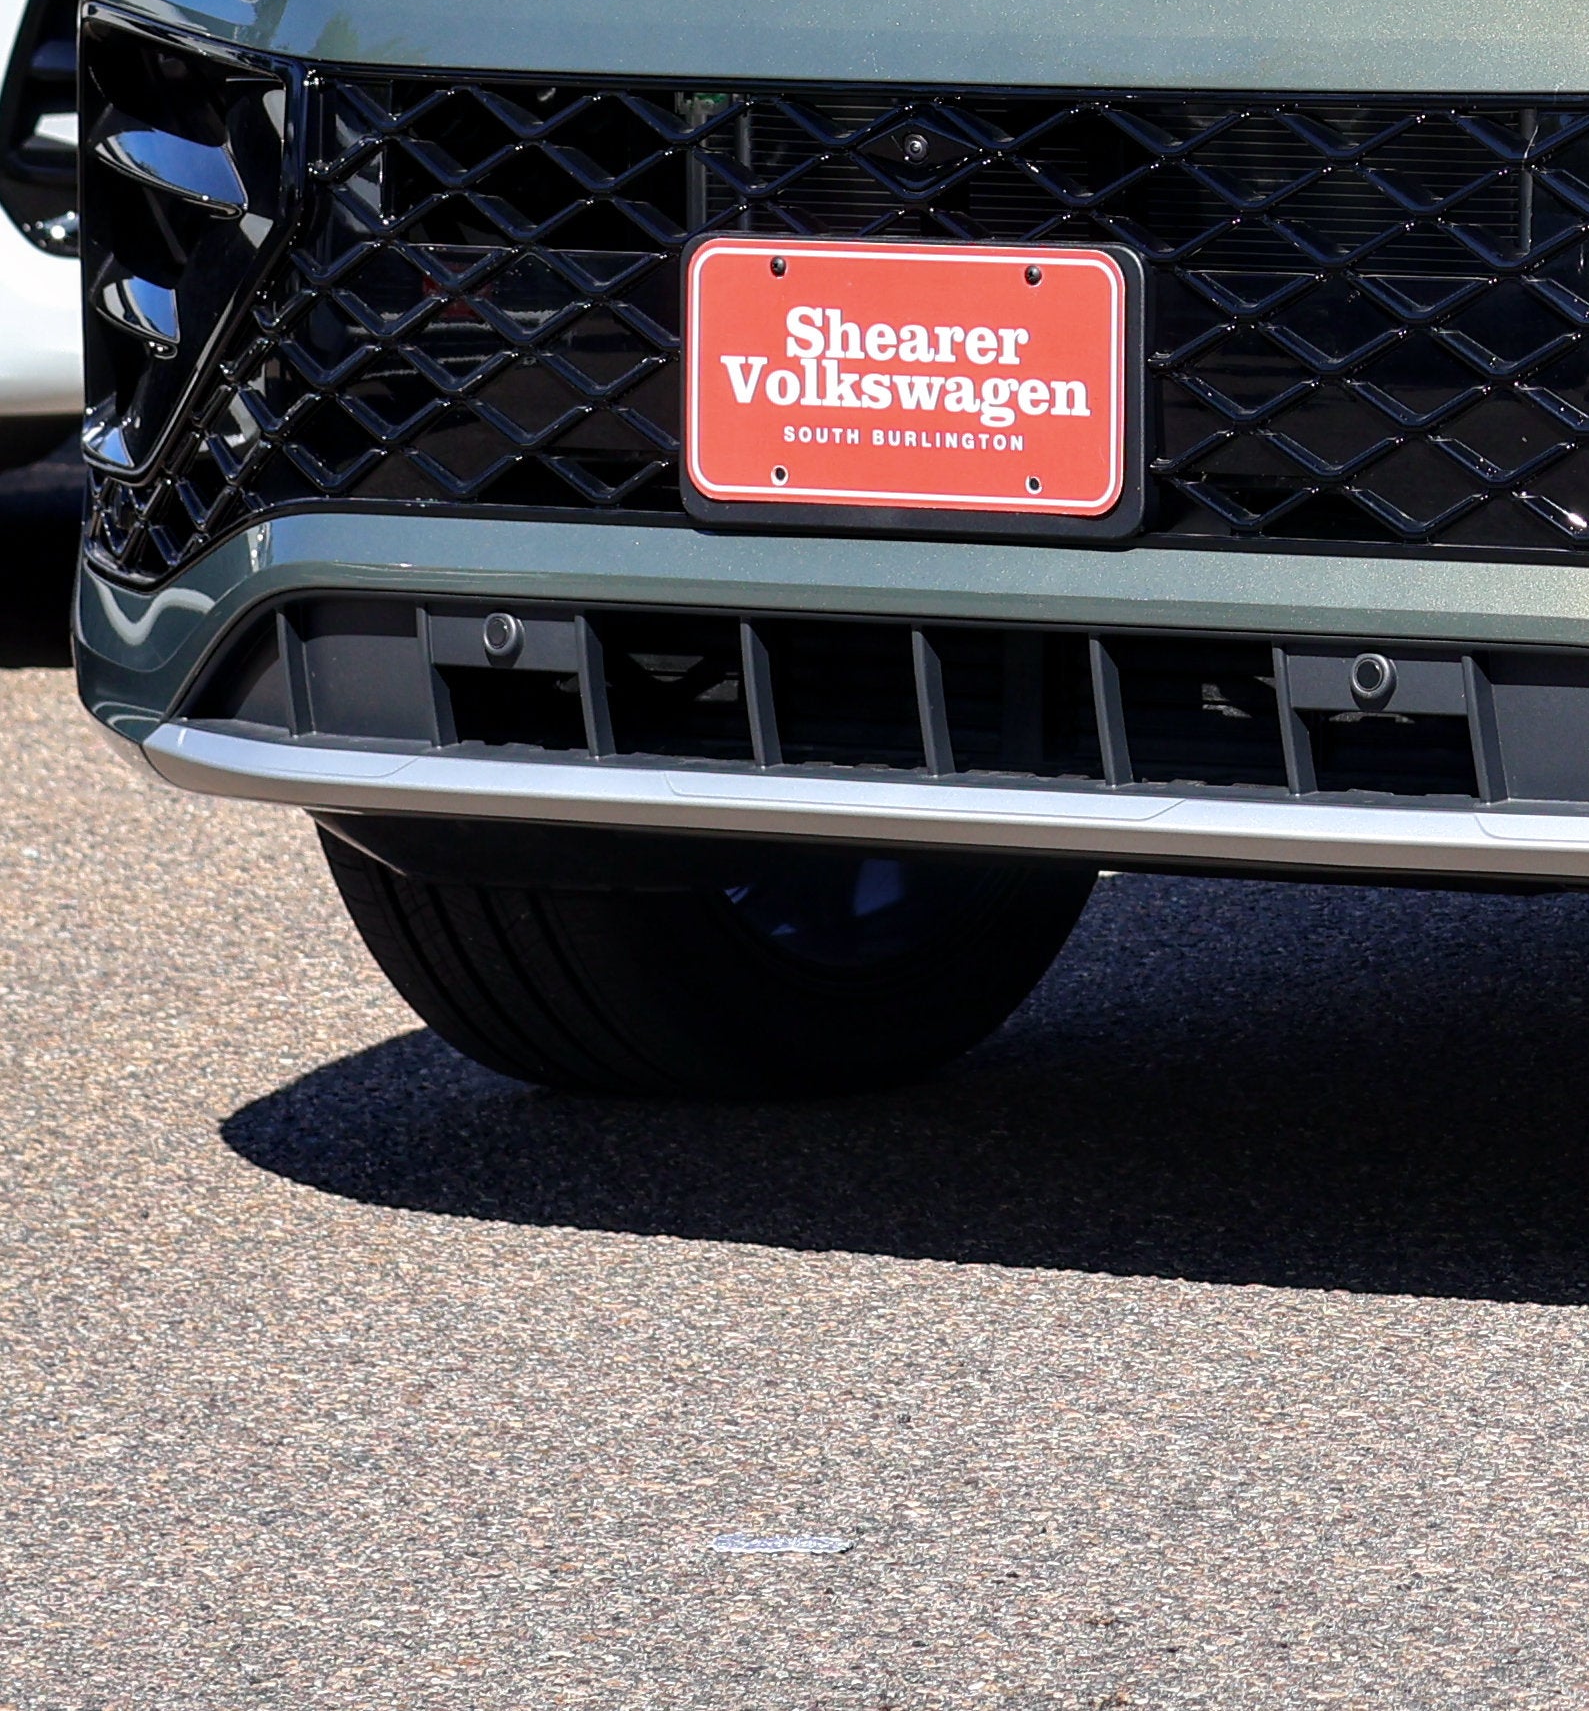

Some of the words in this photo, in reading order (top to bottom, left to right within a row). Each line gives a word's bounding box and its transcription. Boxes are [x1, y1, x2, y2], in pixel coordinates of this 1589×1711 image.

[785, 305, 1030, 365] Shearer
[720, 355, 1090, 428] Volkswagen
[783, 425, 860, 446] SOUTH
[873, 429, 1025, 452] BURLINGTON
